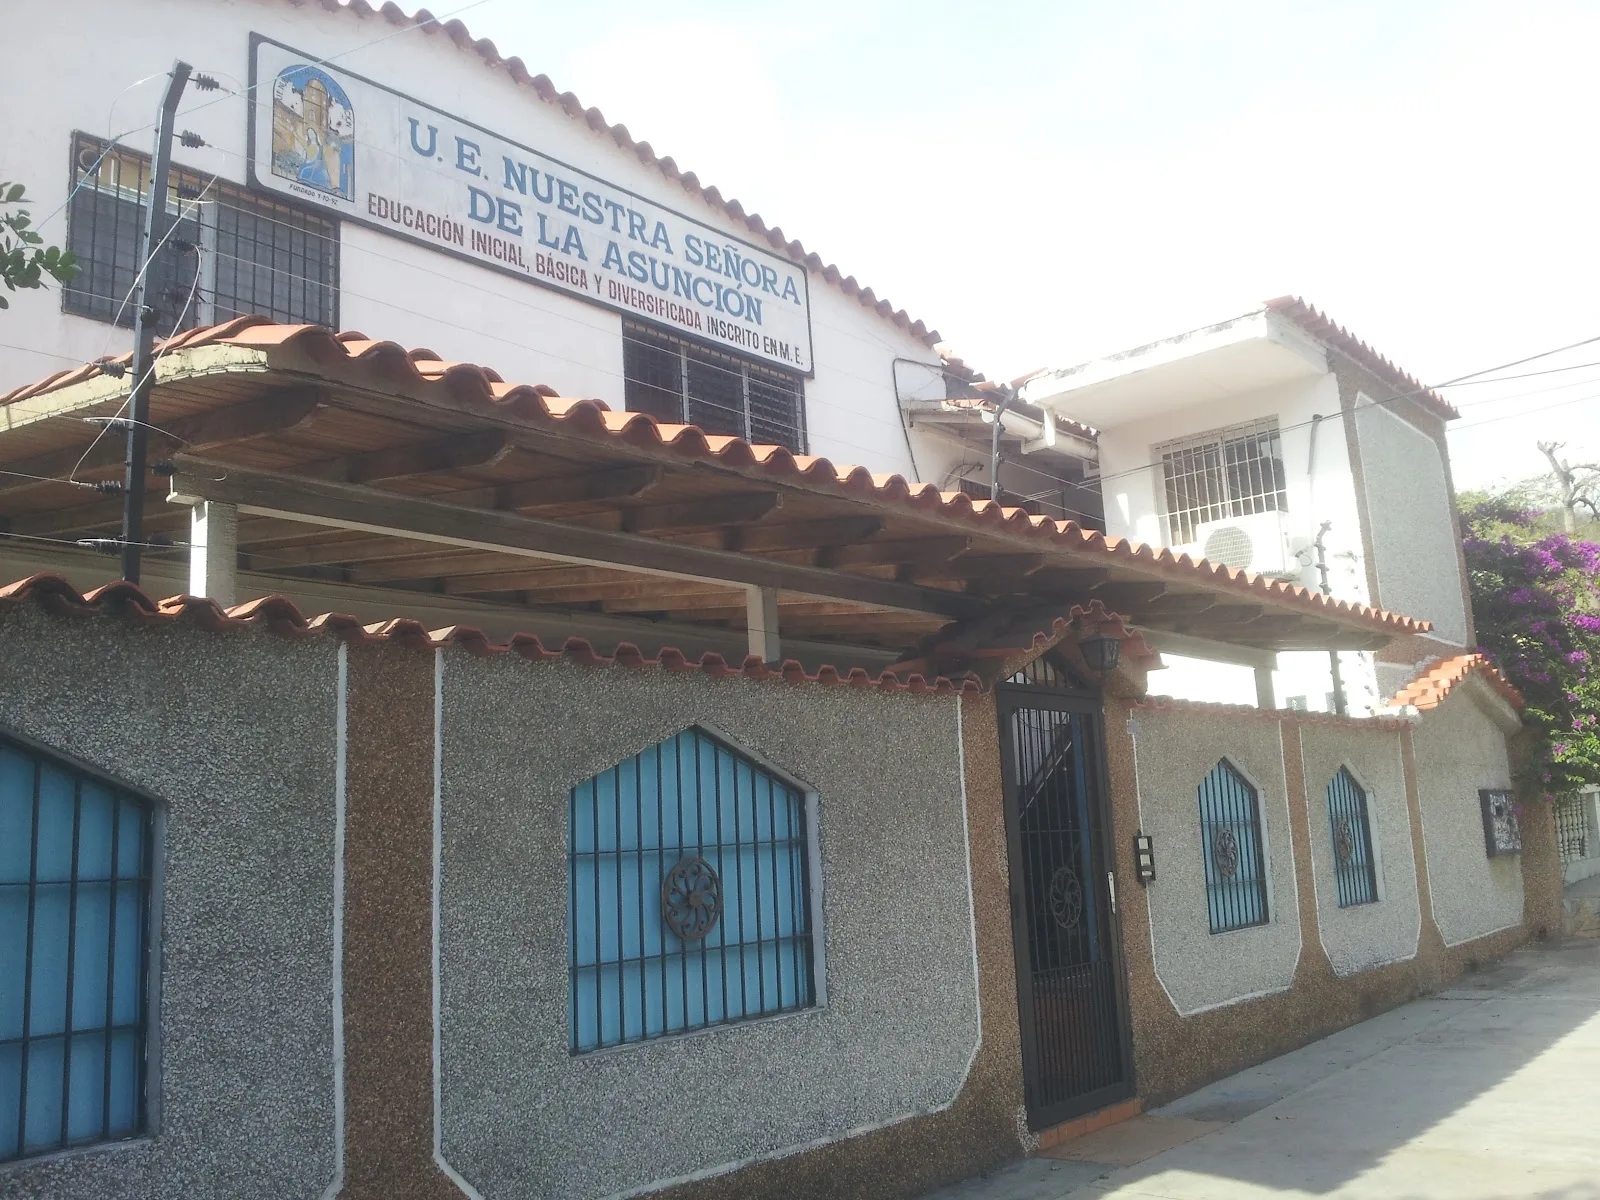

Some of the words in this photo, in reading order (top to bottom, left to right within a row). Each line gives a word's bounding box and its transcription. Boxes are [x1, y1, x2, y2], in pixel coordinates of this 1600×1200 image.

[368, 192, 464, 247] EDUCACIÓN
[471, 228, 530, 273] INICIAL,
[536, 252, 588, 290] BÁSICA
[594, 274, 602, 294] Y
[608, 280, 702, 331] DIVERSIFICADA
[706, 316, 760, 349] INSCRITO
[794, 348, 804, 366] E.
[408, 116, 443, 162] U.
[454, 136, 488, 180] E.
[502, 155, 674, 256] NUESTRA
[684, 234, 801, 306] SEÑORA
[468, 184, 523, 237] DE
[537, 212, 588, 262] LA
[602, 240, 762, 326] ASUNCIÓN
